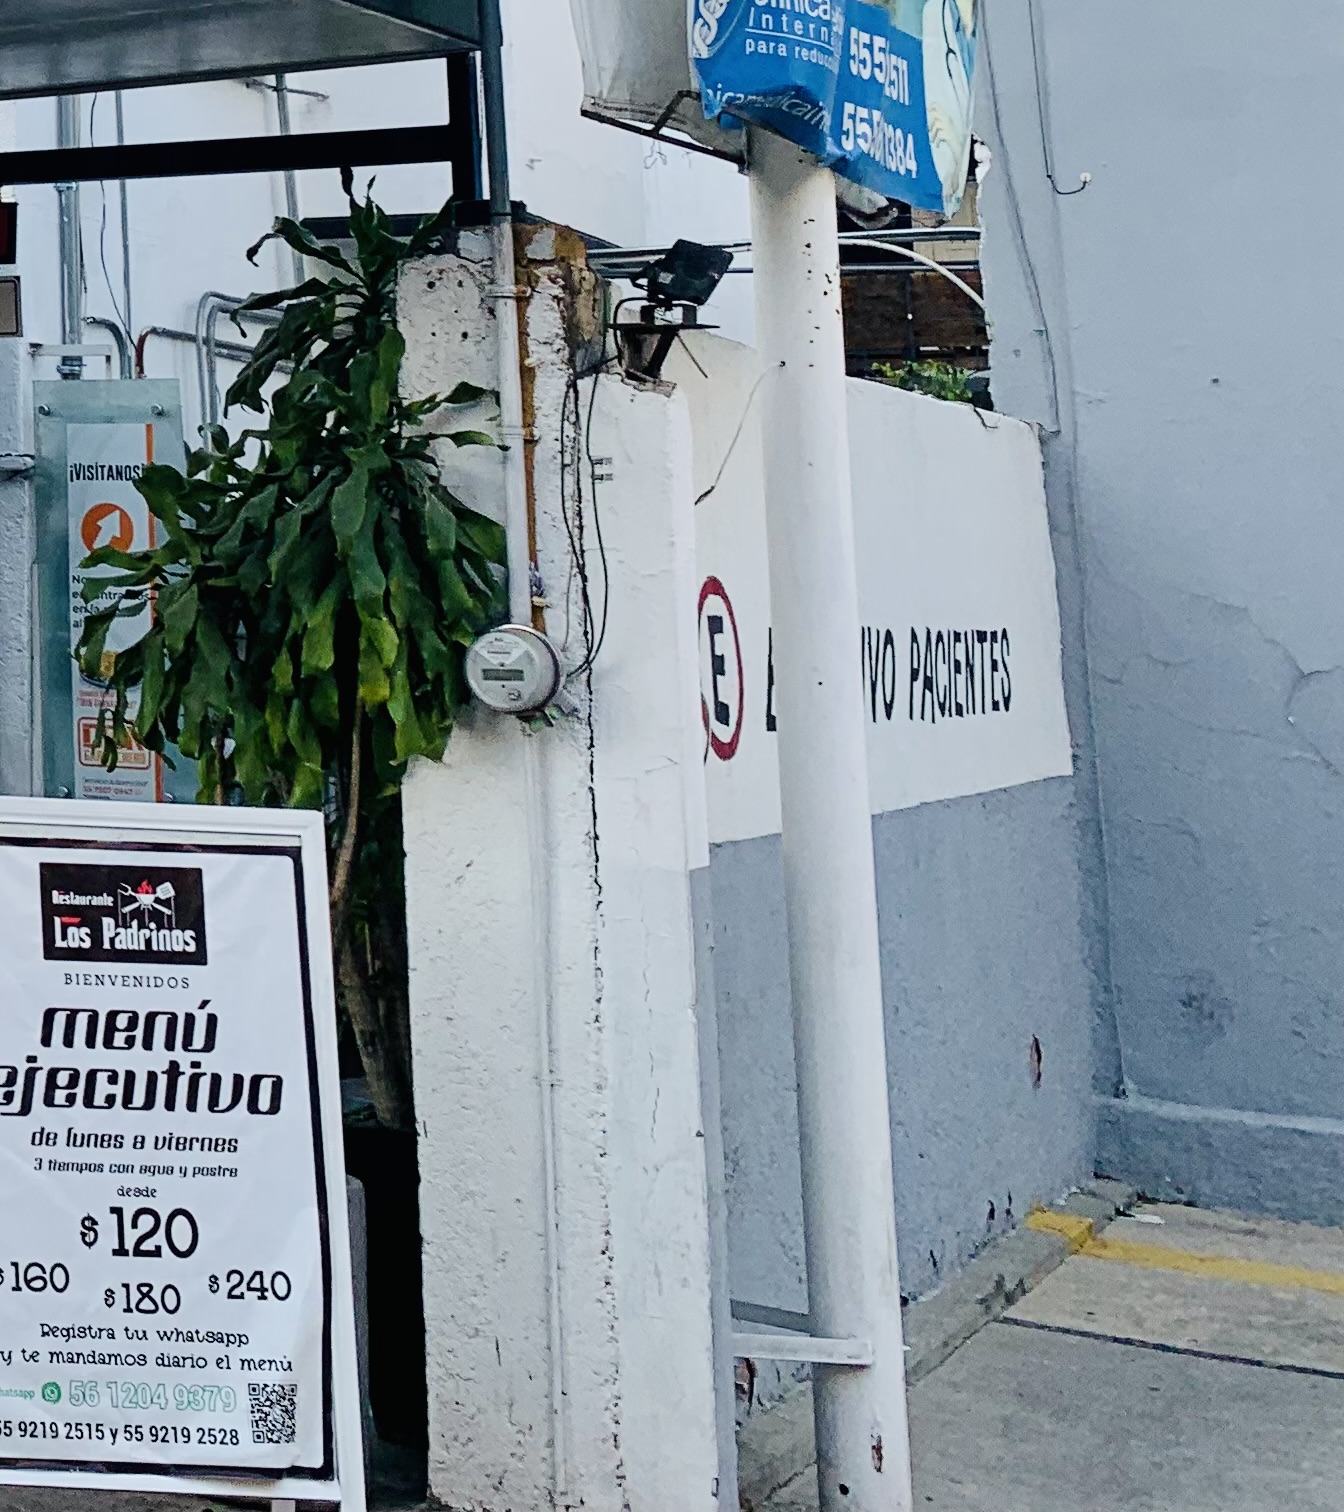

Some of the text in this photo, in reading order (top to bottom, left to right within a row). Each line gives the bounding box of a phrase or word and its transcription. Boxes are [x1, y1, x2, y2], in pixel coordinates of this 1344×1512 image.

[745, 38, 788, 57] para
[909, 625, 1013, 725] PACIENTES
[51, 889, 115, 907] Restaurante
[54, 916, 197, 953] Los Padrinos
[63, 972, 191, 990] BIENVENIDOS
[39, 999, 219, 1054] menú
[30, 1125, 59, 1148] de
[65, 1126, 125, 1150] lunes
[153, 1131, 239, 1154] viernes
[33, 1157, 238, 1179] 3 tiempos con agua y postre
[116, 1184, 158, 1199] desde
[39, 1322, 250, 1348] Registra tu whatsapp
[0, 1347, 293, 1373] y te mandamos diario el menú
[69, 1380, 101, 1408] 56
[106, 1380, 169, 1410] 1204
[172, 1382, 238, 1413] 9379
[17, 1420, 60, 1439] 9219
[64, 1422, 105, 1440] 2515
[108, 1426, 119, 1445] y
[123, 1424, 145, 1442] 55
[149, 1425, 191, 1443] 9219
[196, 1427, 240, 1446] 2528
